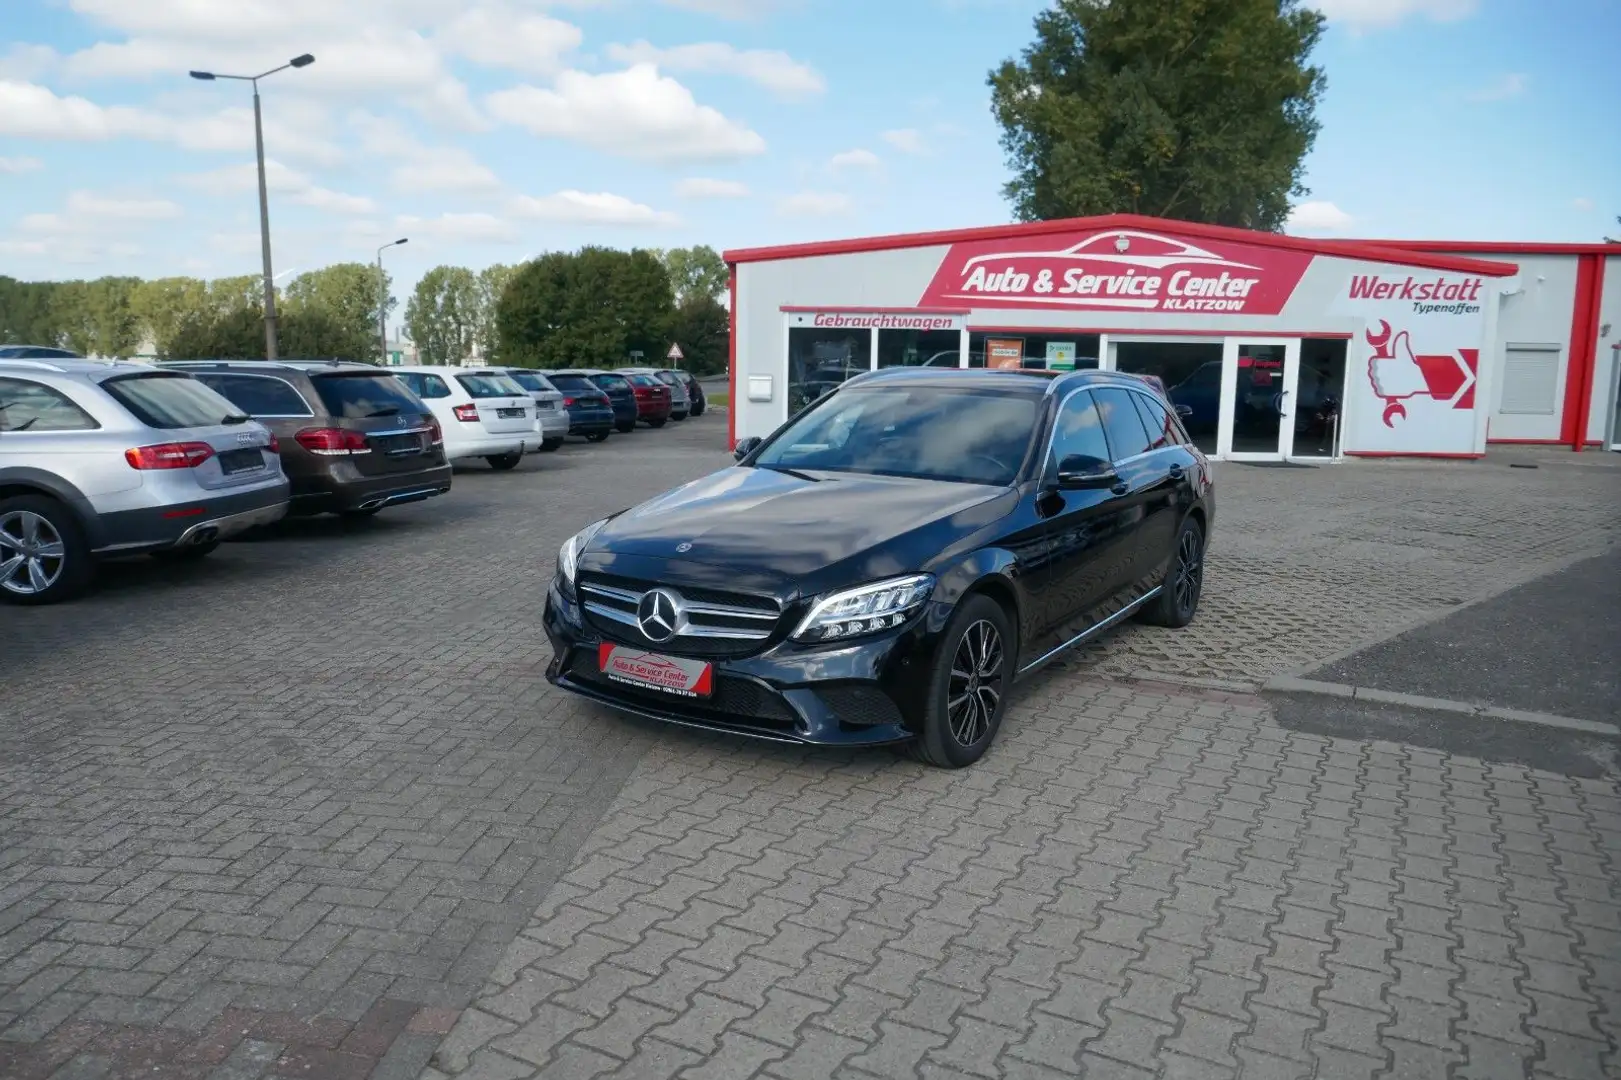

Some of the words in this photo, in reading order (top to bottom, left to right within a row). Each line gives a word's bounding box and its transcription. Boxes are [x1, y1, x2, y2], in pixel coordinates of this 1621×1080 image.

[961, 266, 1030, 293] Auto
[1033, 267, 1054, 294] &
[1058, 268, 1162, 295] Service
[1167, 270, 1260, 298] Center
[1349, 275, 1484, 301] Werkstatt
[1162, 298, 1245, 311] KLATZOW
[1413, 301, 1480, 315] Typenoffen
[814, 312, 953, 331] Gebrauchtwagen
[613, 660, 629, 670] Auto
[635, 665, 663, 676] Service
[664, 669, 690, 682] Center
[649, 676, 686, 688] KLATZOW
